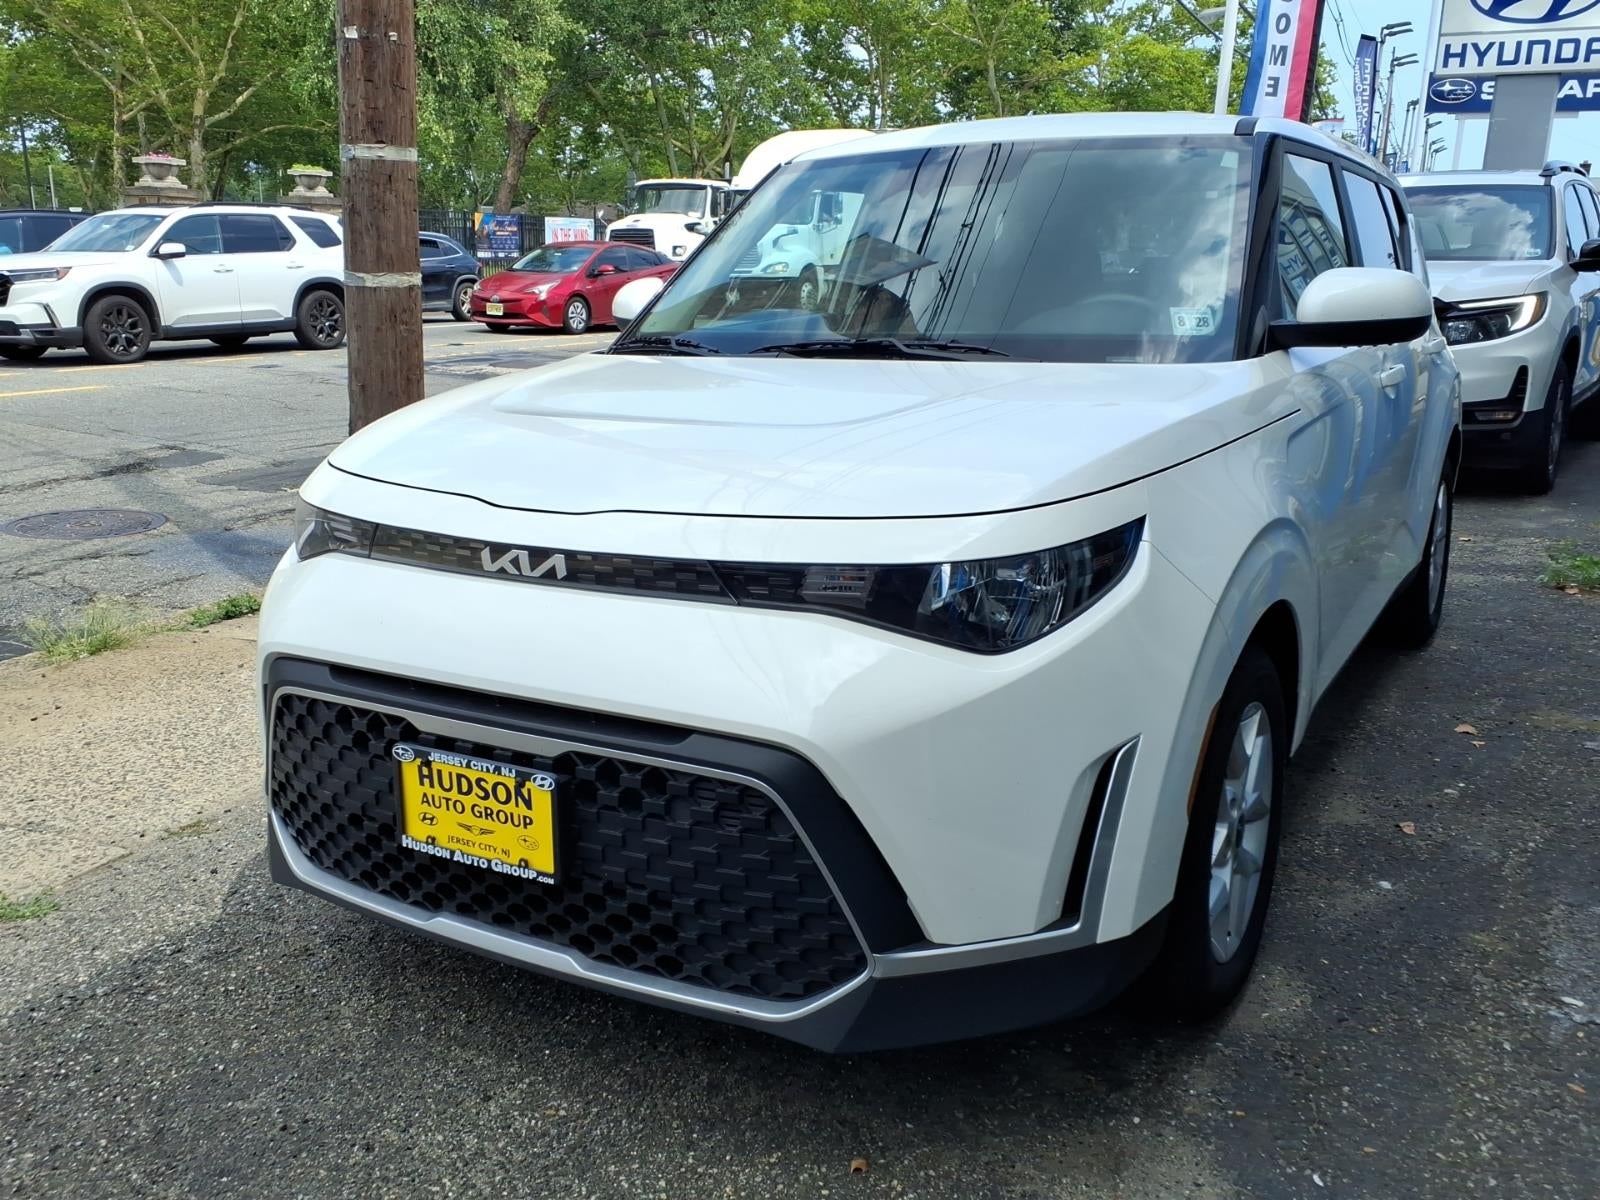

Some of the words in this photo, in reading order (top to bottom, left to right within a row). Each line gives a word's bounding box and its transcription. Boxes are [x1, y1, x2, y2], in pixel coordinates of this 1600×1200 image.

[481, 546, 567, 580] KIA
[428, 752, 468, 767] JERSEY
[471, 760, 498, 775] CITY,
[501, 767, 516, 778] NJ
[417, 763, 533, 811] HUDSON
[421, 792, 466, 815] AUTO
[471, 803, 533, 829] GROUP
[401, 834, 450, 859] HUDSON
[453, 850, 488, 869] AUTO
[447, 834, 477, 848] JERSEY
[501, 847, 511, 859] NJ
